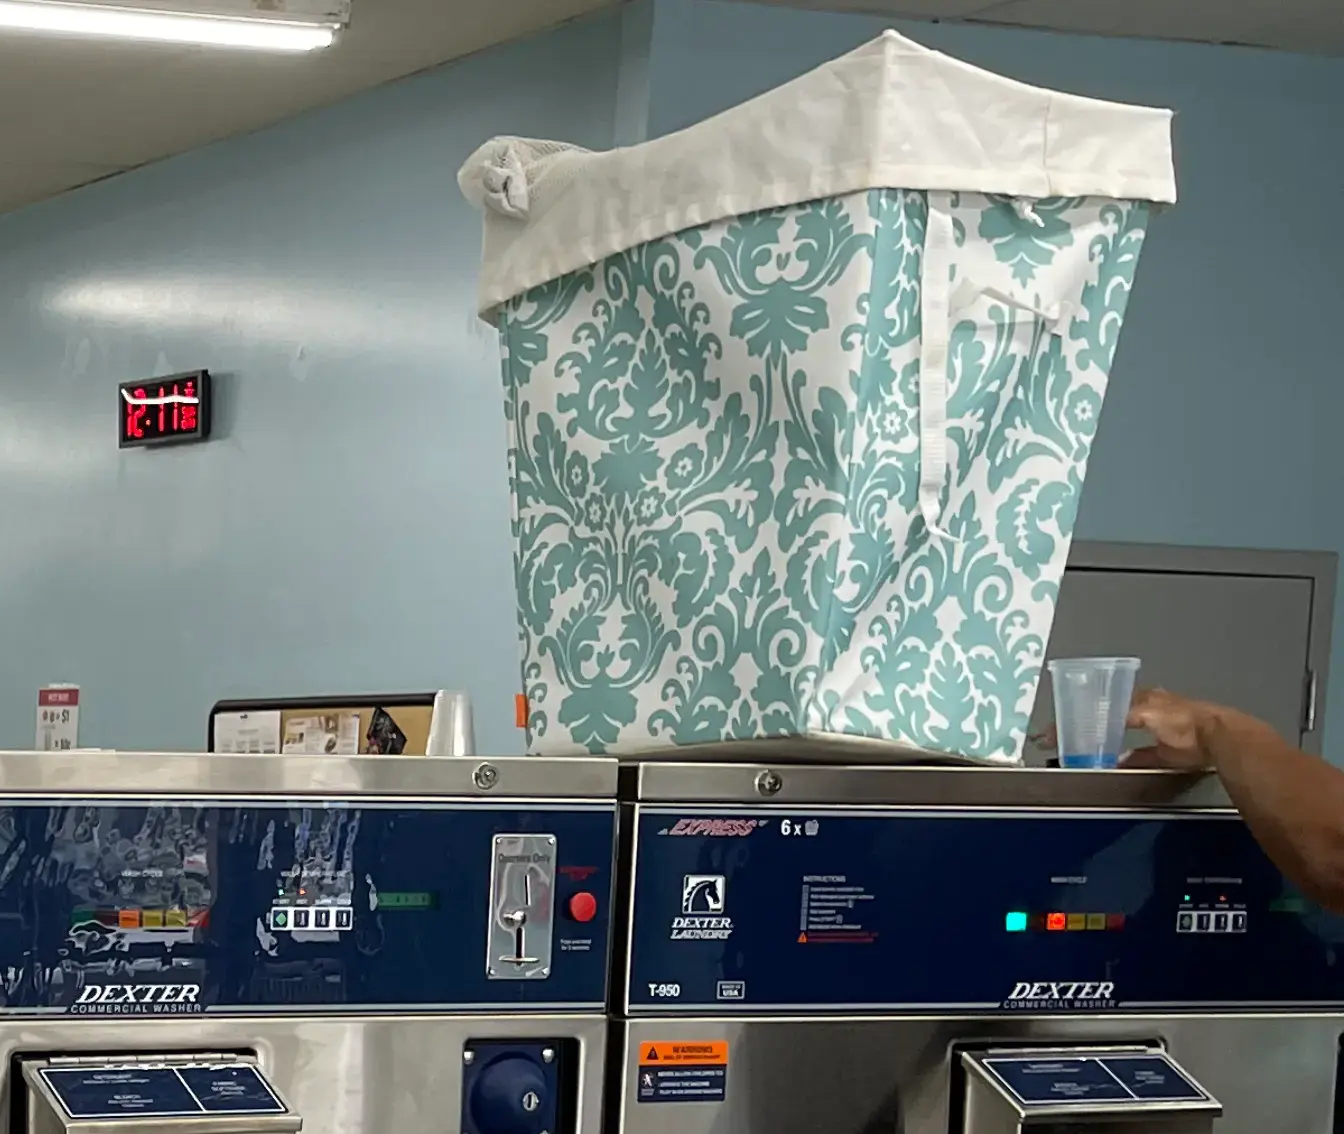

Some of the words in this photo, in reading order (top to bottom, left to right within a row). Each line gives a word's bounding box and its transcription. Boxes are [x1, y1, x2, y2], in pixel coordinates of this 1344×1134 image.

[669, 819, 757, 836] EXPRESS
[781, 820, 791, 835] 6
[794, 825, 801, 835] x
[671, 917, 731, 928] DEXTER
[671, 930, 732, 939] LAUNDRY
[75, 984, 200, 1003] DEXTER
[648, 984, 680, 996] T-950
[1008, 981, 1114, 999] DEXTER
[71, 1005, 148, 1013] COMMERCIAL
[1003, 1000, 1068, 1008] COMMERCIAL
